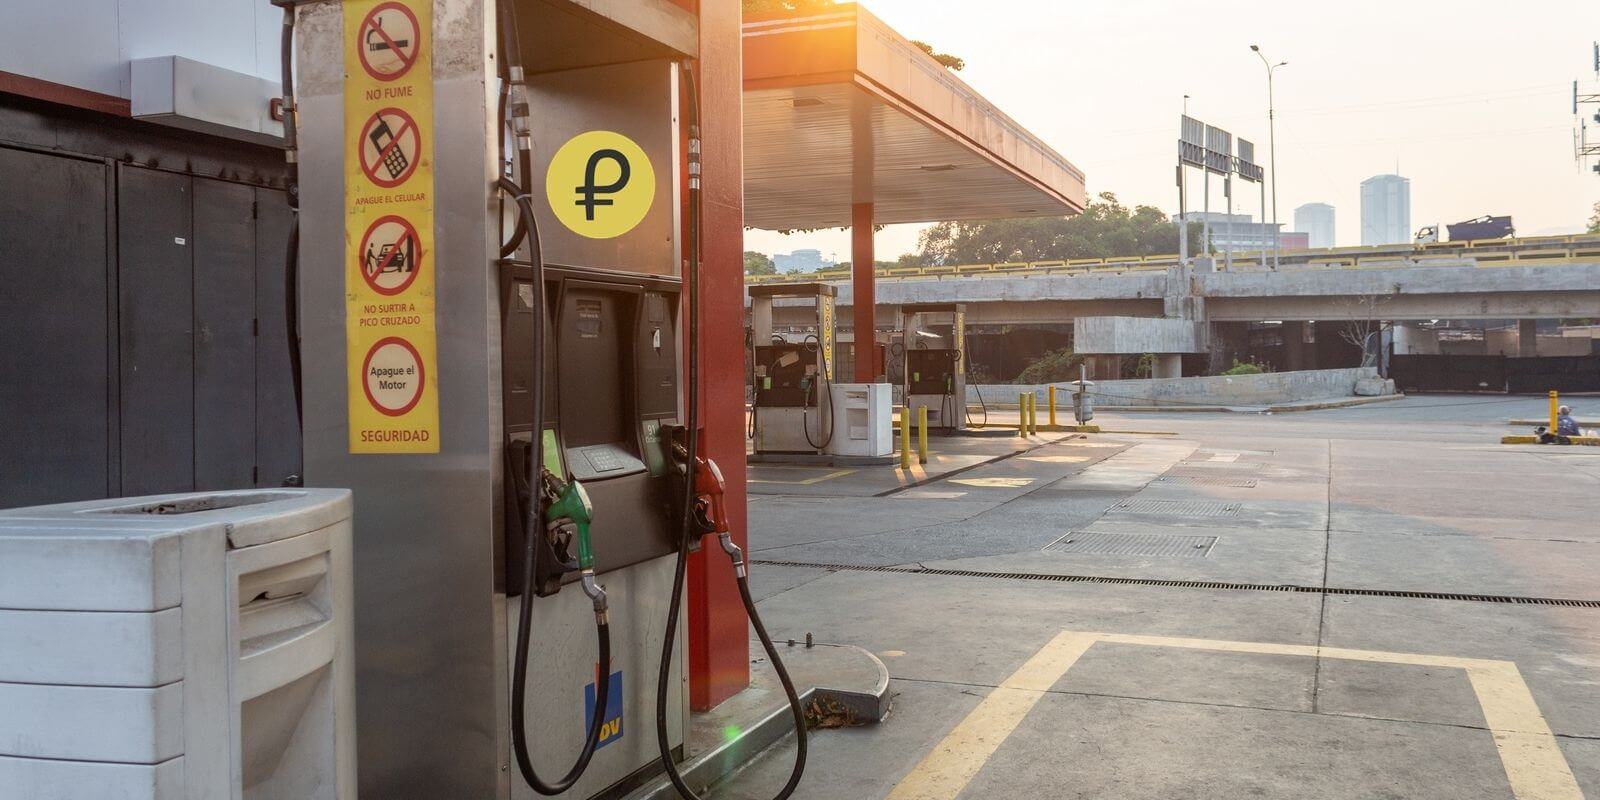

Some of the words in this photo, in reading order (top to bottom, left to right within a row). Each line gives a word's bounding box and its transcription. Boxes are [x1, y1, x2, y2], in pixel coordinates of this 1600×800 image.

[366, 89, 381, 100] NO
[384, 86, 413, 99] FUME
[355, 196, 383, 205] APAGUE
[385, 195, 393, 203] EL
[394, 193, 426, 203] CELULAR
[364, 305, 377, 314] NO
[378, 304, 408, 313] SURTIR
[409, 304, 415, 312] A
[359, 318, 378, 327] PICO
[380, 315, 421, 326] CRUZADO
[370, 366, 404, 378] Apague
[406, 365, 415, 375] el
[379, 380, 407, 390] Motor
[361, 430, 429, 442] SEGURIDAD
[598, 717, 621, 742] DV
